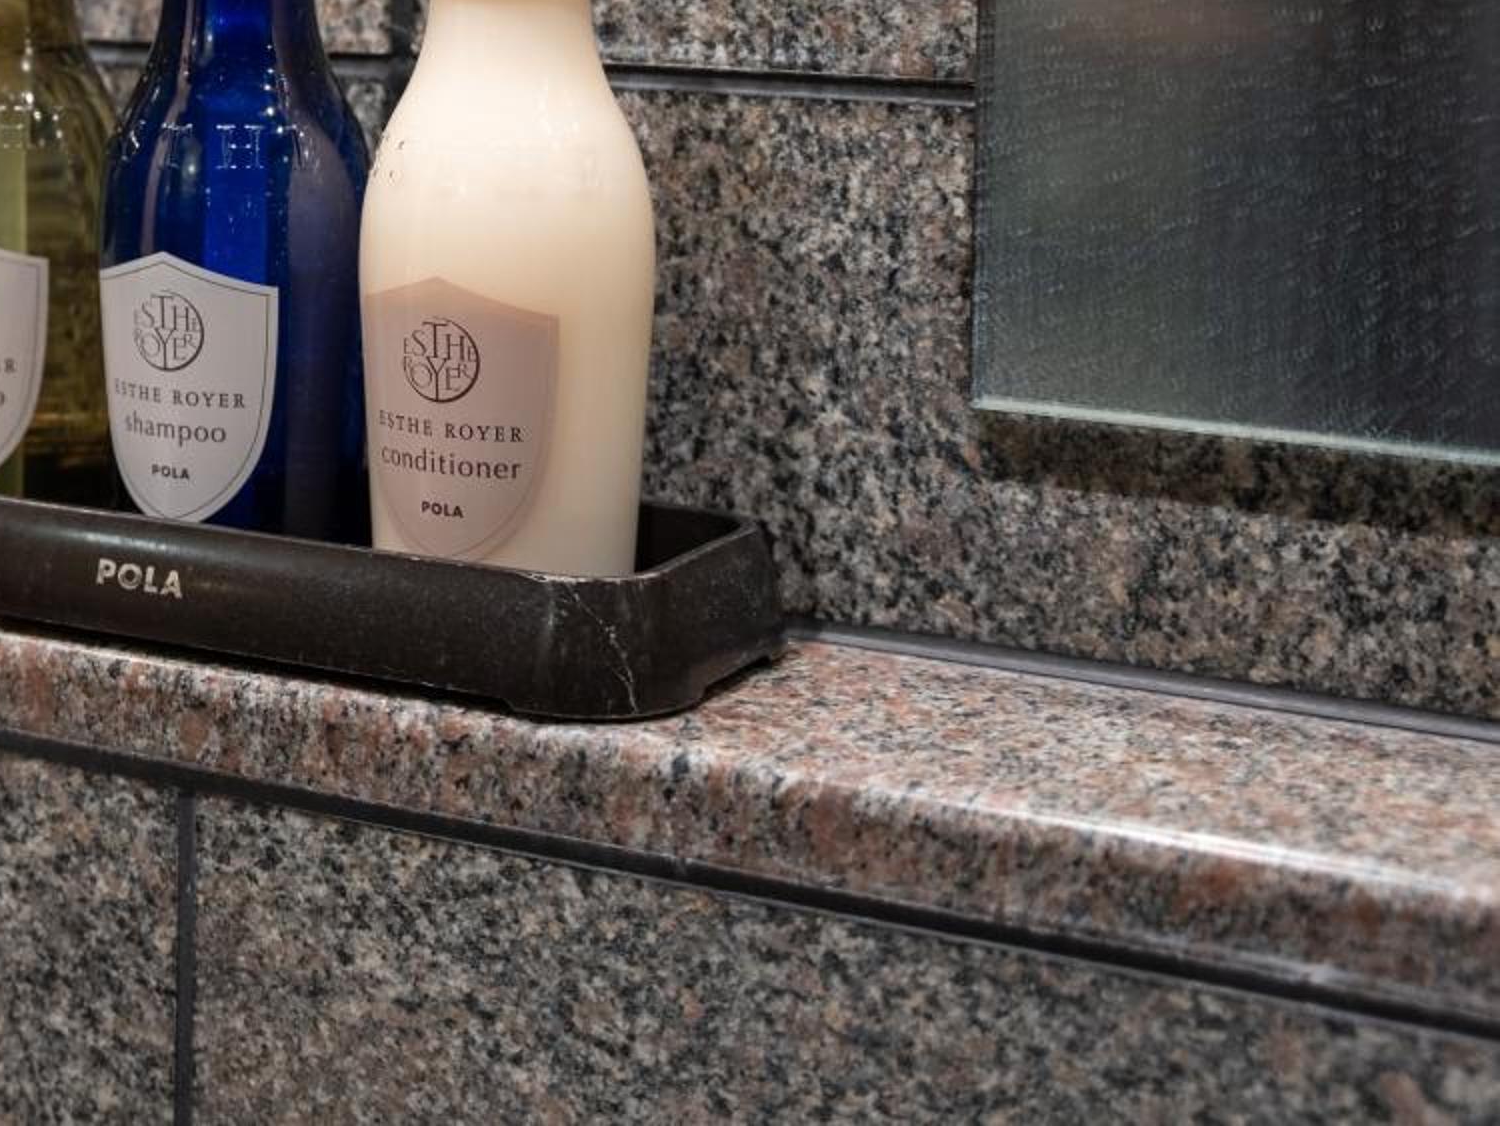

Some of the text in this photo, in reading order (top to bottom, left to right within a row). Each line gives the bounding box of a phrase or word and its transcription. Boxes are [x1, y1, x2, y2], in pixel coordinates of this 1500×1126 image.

[172, 390, 246, 409] ROYER
[125, 410, 227, 447] shampoo
[379, 409, 525, 443] ESTHE ROYER
[151, 464, 190, 480] POLA
[381, 445, 522, 480] conditioner
[420, 501, 464, 519] POLA
[96, 557, 183, 599] POLA
